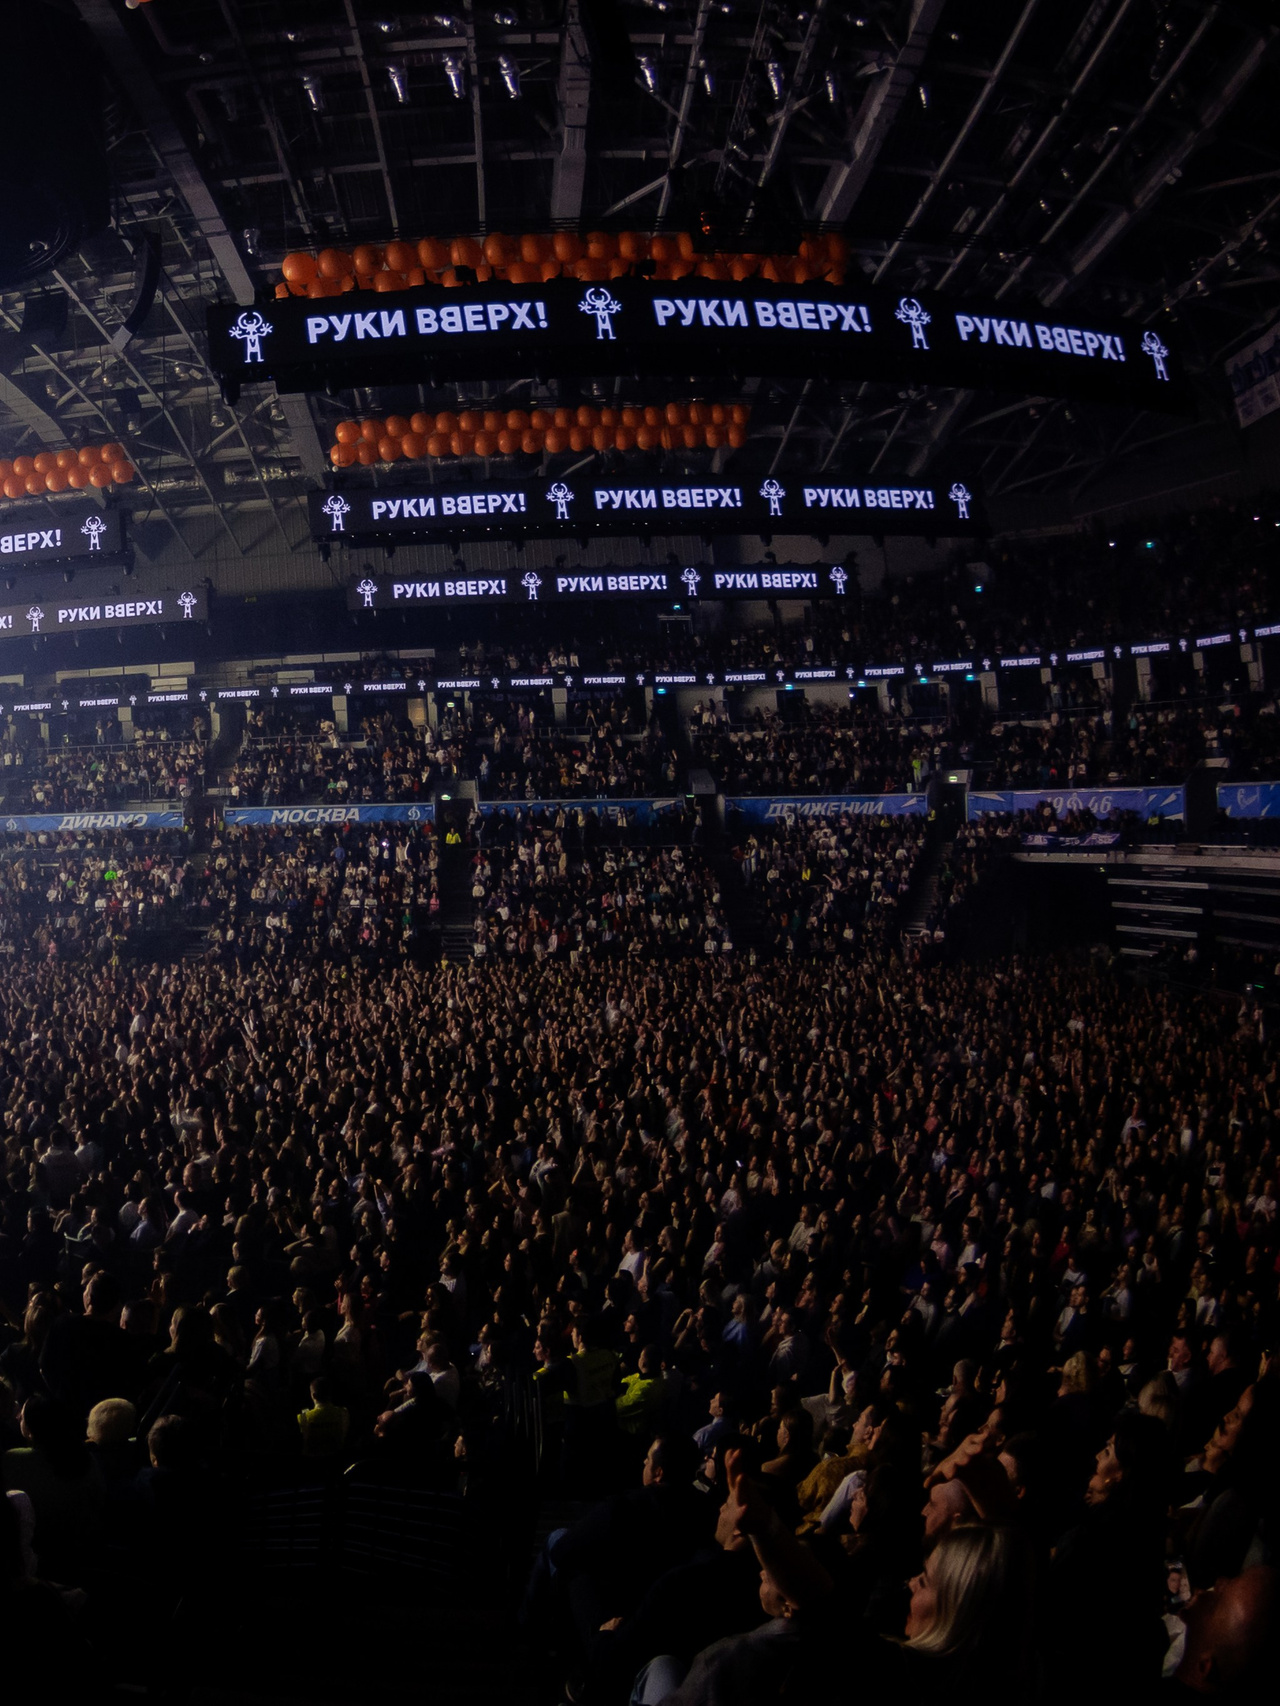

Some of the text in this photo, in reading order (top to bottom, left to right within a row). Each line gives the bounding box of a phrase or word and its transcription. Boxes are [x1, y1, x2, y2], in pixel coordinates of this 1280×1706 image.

[306, 301, 549, 344] РУКИ ВВЕРХ!
[652, 298, 872, 333] РУКИ ВВЕРХ!
[955, 314, 1126, 362] РУКИ ВВЕРХ!
[371, 492, 527, 520] РУКИ ВВЕРХ!
[594, 487, 743, 510] РУКИ ВВЕРХ!
[803, 487, 935, 510] РУКИ ВВЕРХ!
[392, 579, 507, 599] РУКИ ВВЕРХ!
[556, 574, 668, 593] РУКИ ВВЕРХ!
[714, 572, 818, 589] РУКИ ВВЕРХ!
[58, 599, 163, 624] РУКИ ВВЕРХ!
[270, 808, 360, 823] МОСКВА
[1088, 796, 1113, 814] 46
[58, 813, 148, 831] ДИНАМО
